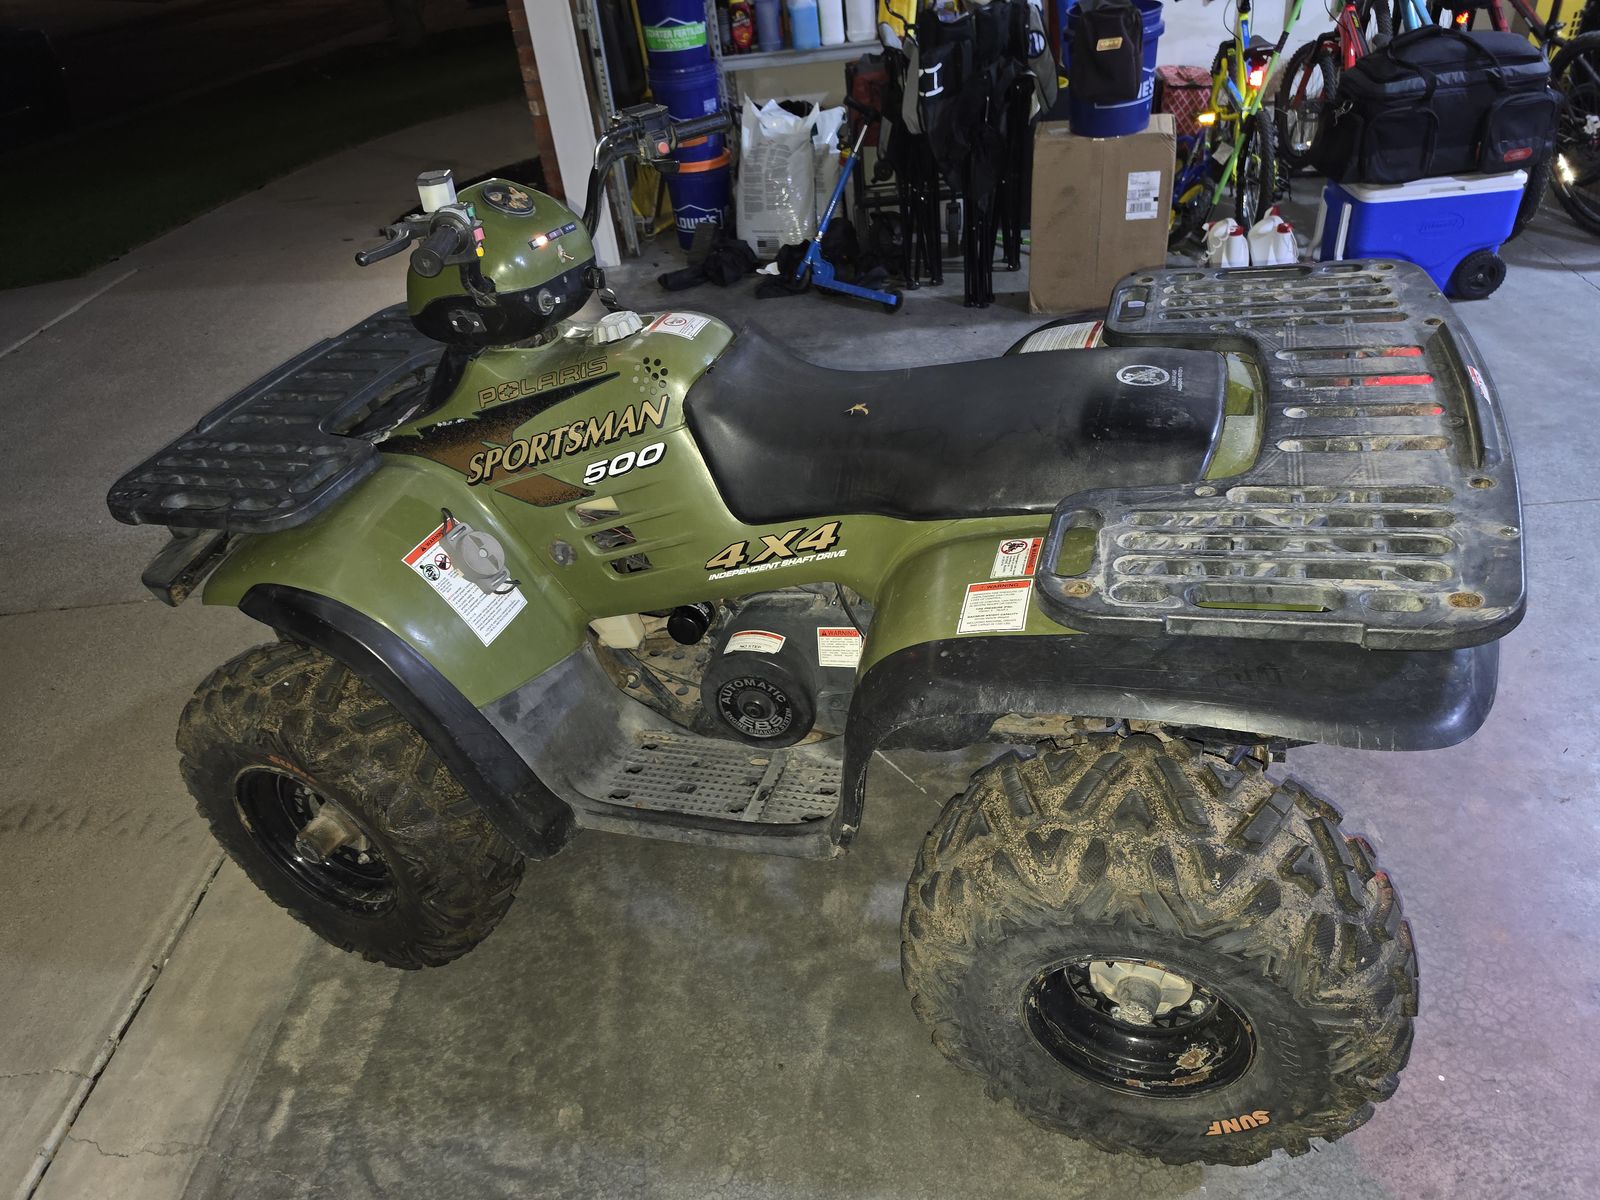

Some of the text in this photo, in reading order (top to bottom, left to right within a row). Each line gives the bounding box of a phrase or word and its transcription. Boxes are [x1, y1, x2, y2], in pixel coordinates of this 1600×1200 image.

[478, 356, 608, 408] POLARIS
[467, 394, 670, 486] SPORTSMAN
[583, 441, 667, 486] 500
[704, 521, 842, 570] 4X4
[708, 549, 848, 581] INDEPENDENT SHAFT DRIVE
[722, 679, 786, 704] AUTOMATIC
[725, 711, 747, 730] ENGINE
[749, 727, 779, 736] BRAKING
[739, 715, 783, 730] EBS
[1205, 1110, 1271, 1136] SUNF
